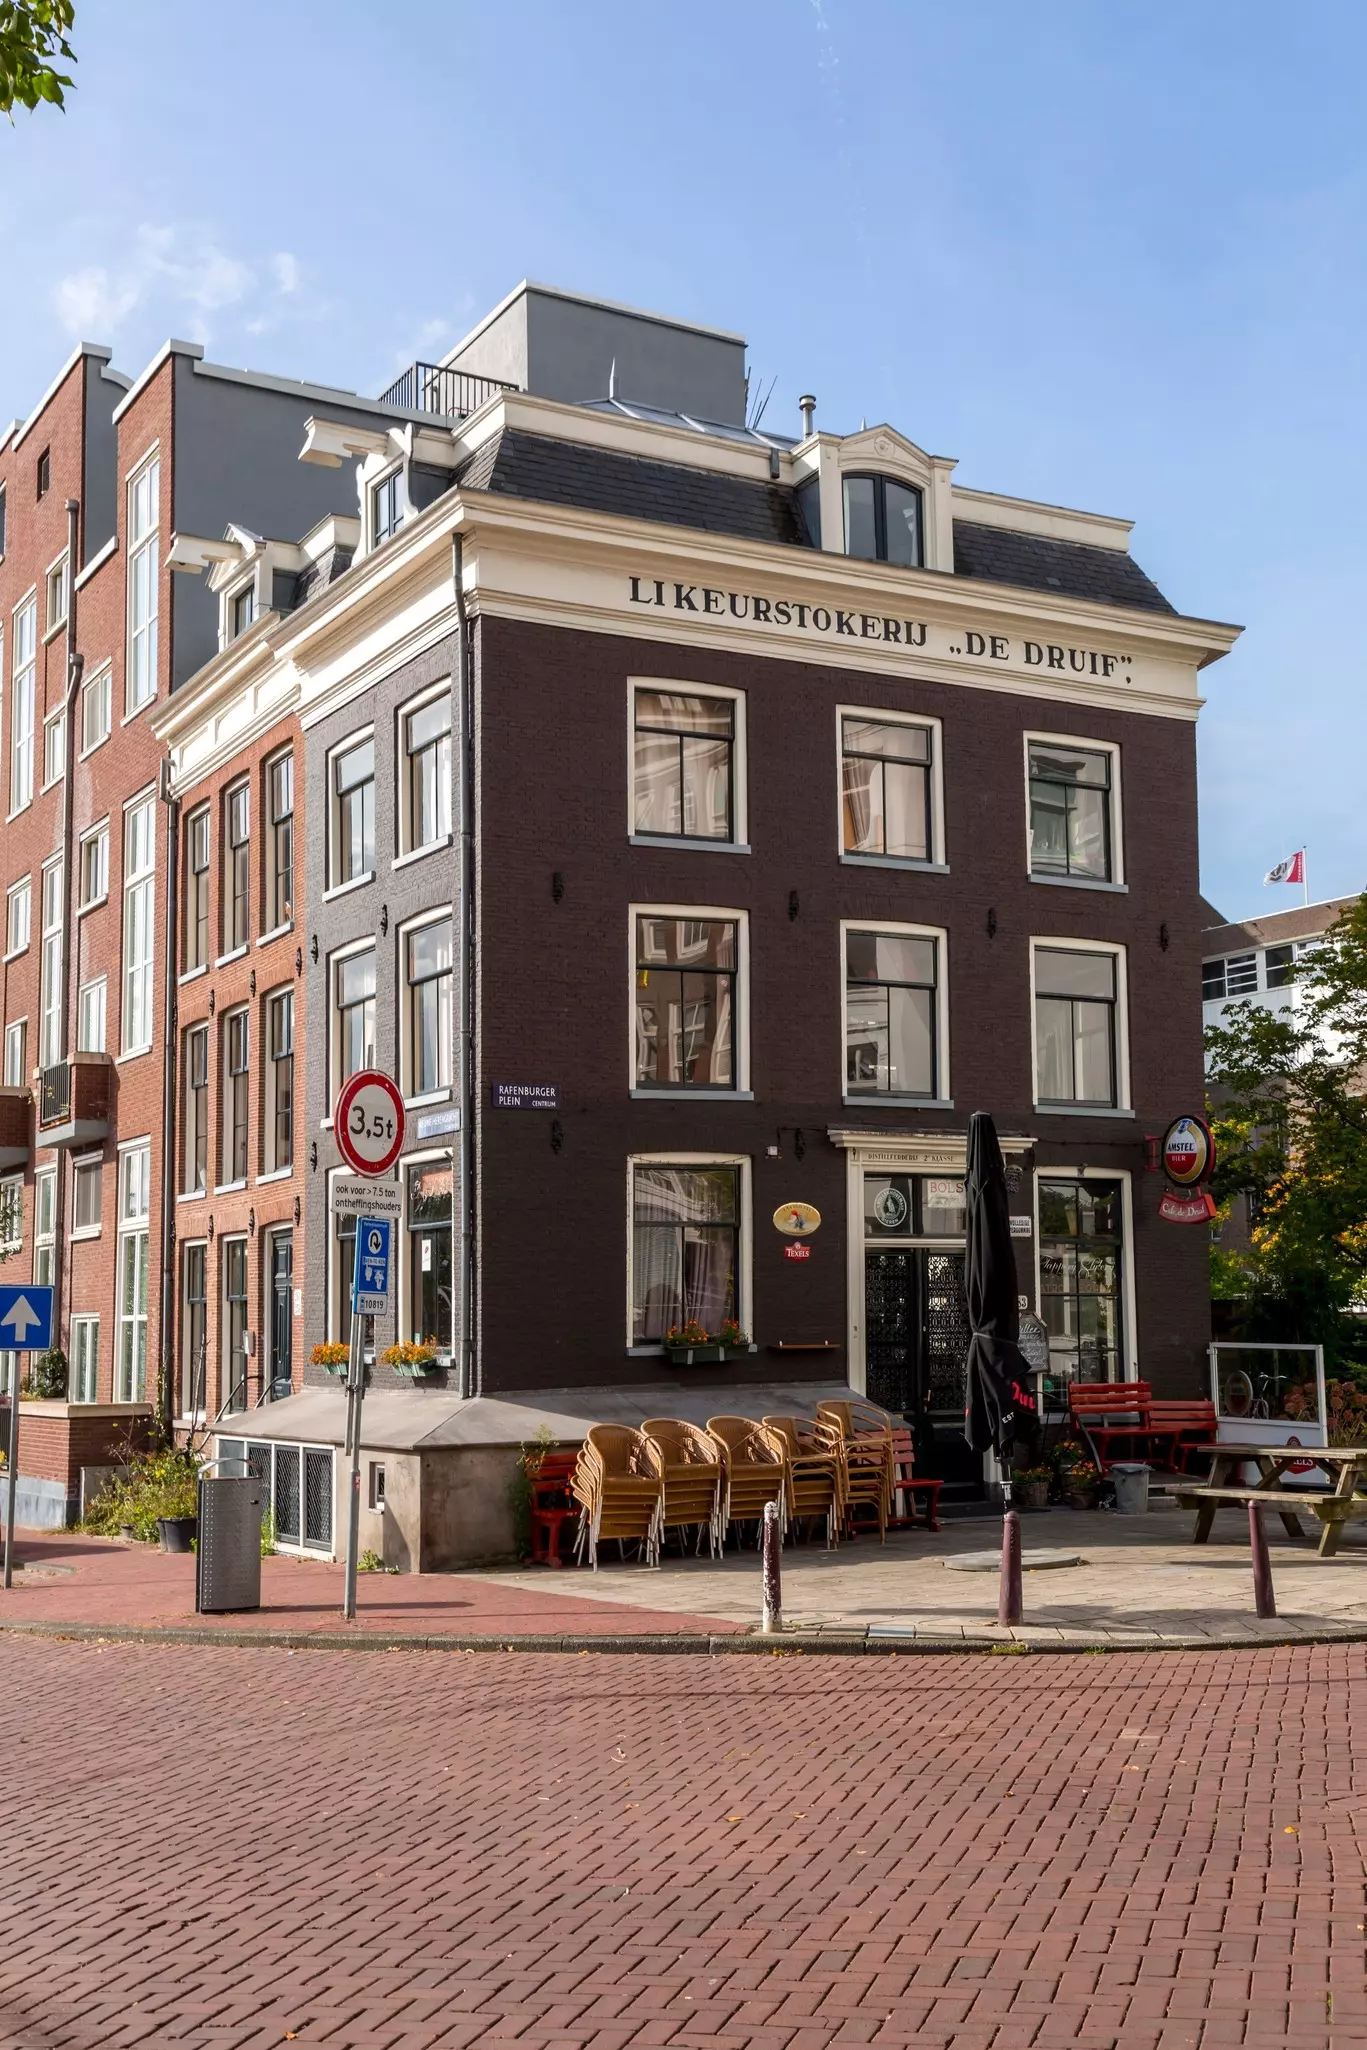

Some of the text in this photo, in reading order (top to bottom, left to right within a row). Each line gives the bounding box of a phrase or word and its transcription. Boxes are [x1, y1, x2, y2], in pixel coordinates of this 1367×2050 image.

[628, 576, 928, 647] LIKEURSTOKERIJ
[498, 1096, 521, 1106] PLEIN
[1167, 1142, 1194, 1152] AMSTEL
[1171, 1154, 1186, 1162] BIER
[335, 1184, 349, 1194] ook
[350, 1186, 366, 1195] voor
[384, 1188, 396, 1198] ton
[929, 1181, 964, 1194] BOLS
[335, 1198, 402, 1212] ontheffingshouders
[785, 1248, 810, 1258] TEXELS
[365, 1300, 384, 1309] 10819
[1001, 1411, 1015, 1424] EST
